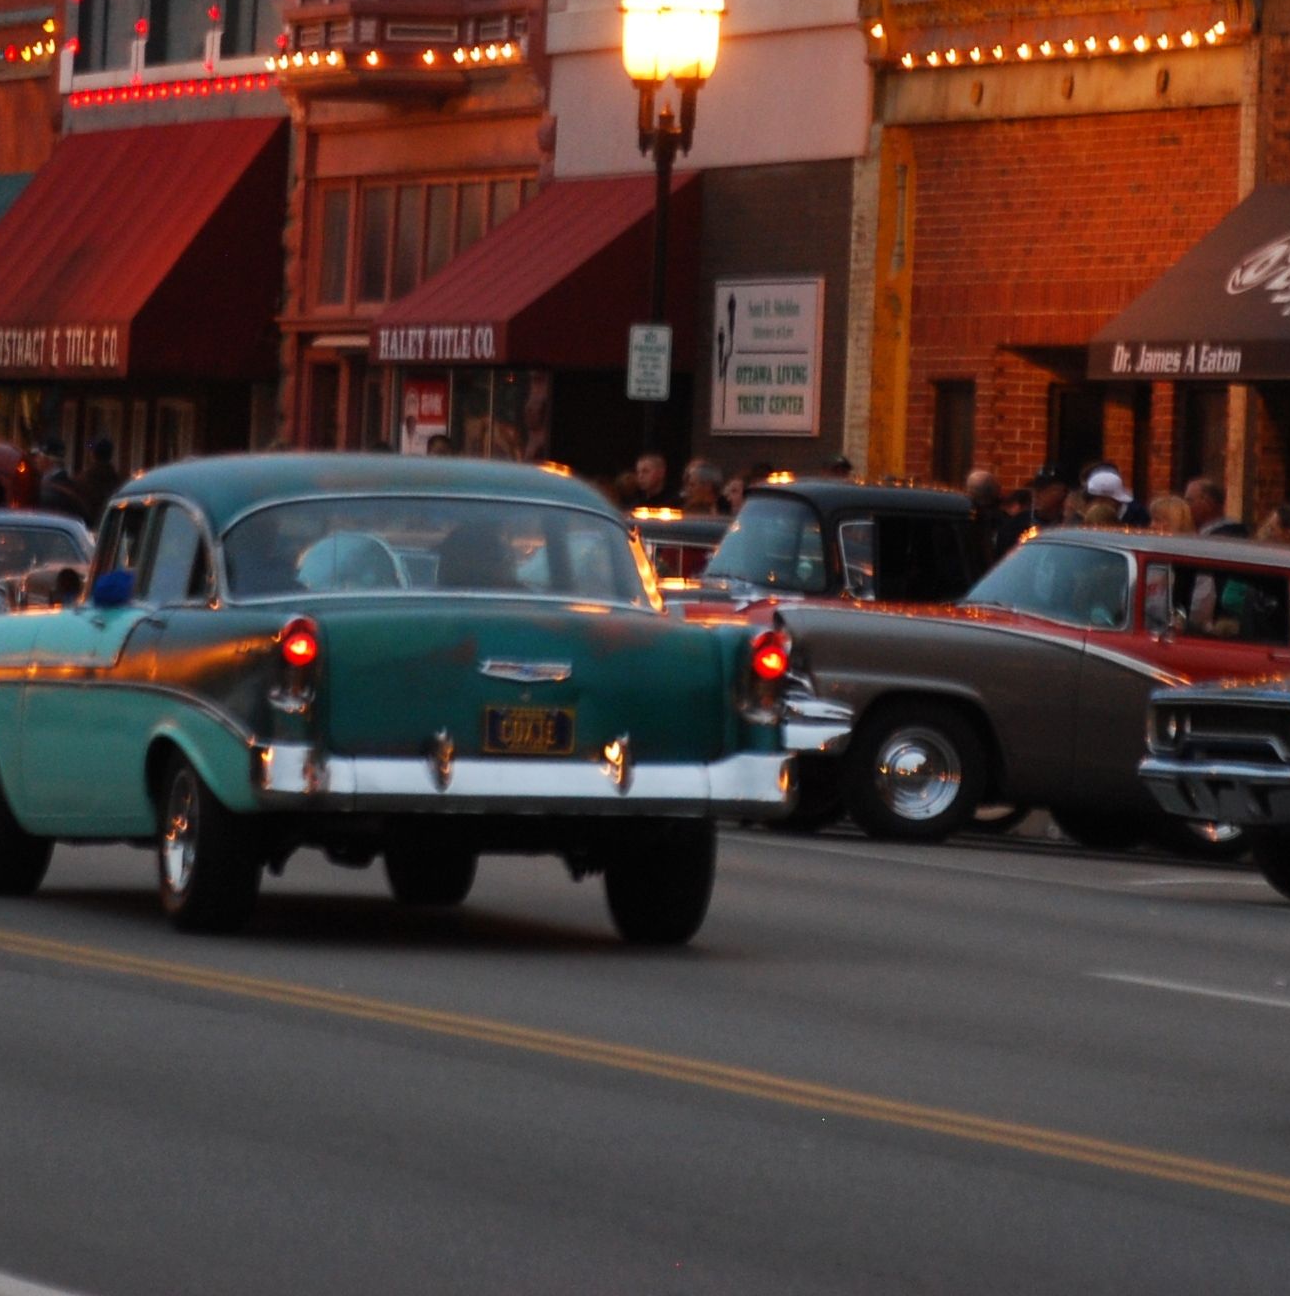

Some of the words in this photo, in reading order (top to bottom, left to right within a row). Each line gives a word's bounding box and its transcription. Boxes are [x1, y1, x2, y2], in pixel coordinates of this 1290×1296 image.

[65, 327, 95, 367] TITLE
[101, 328, 119, 367] CO.
[378, 327, 426, 360] HALEY
[429, 327, 471, 360] TITLE
[473, 325, 496, 360] CO.
[1112, 342, 1132, 373] Dr.
[1135, 343, 1181, 373] James
[1185, 343, 1196, 372] A
[1198, 342, 1242, 373] Eaton
[735, 364, 773, 386] OTTAWA
[777, 363, 808, 386] LIVING
[769, 395, 805, 416] CENTER
